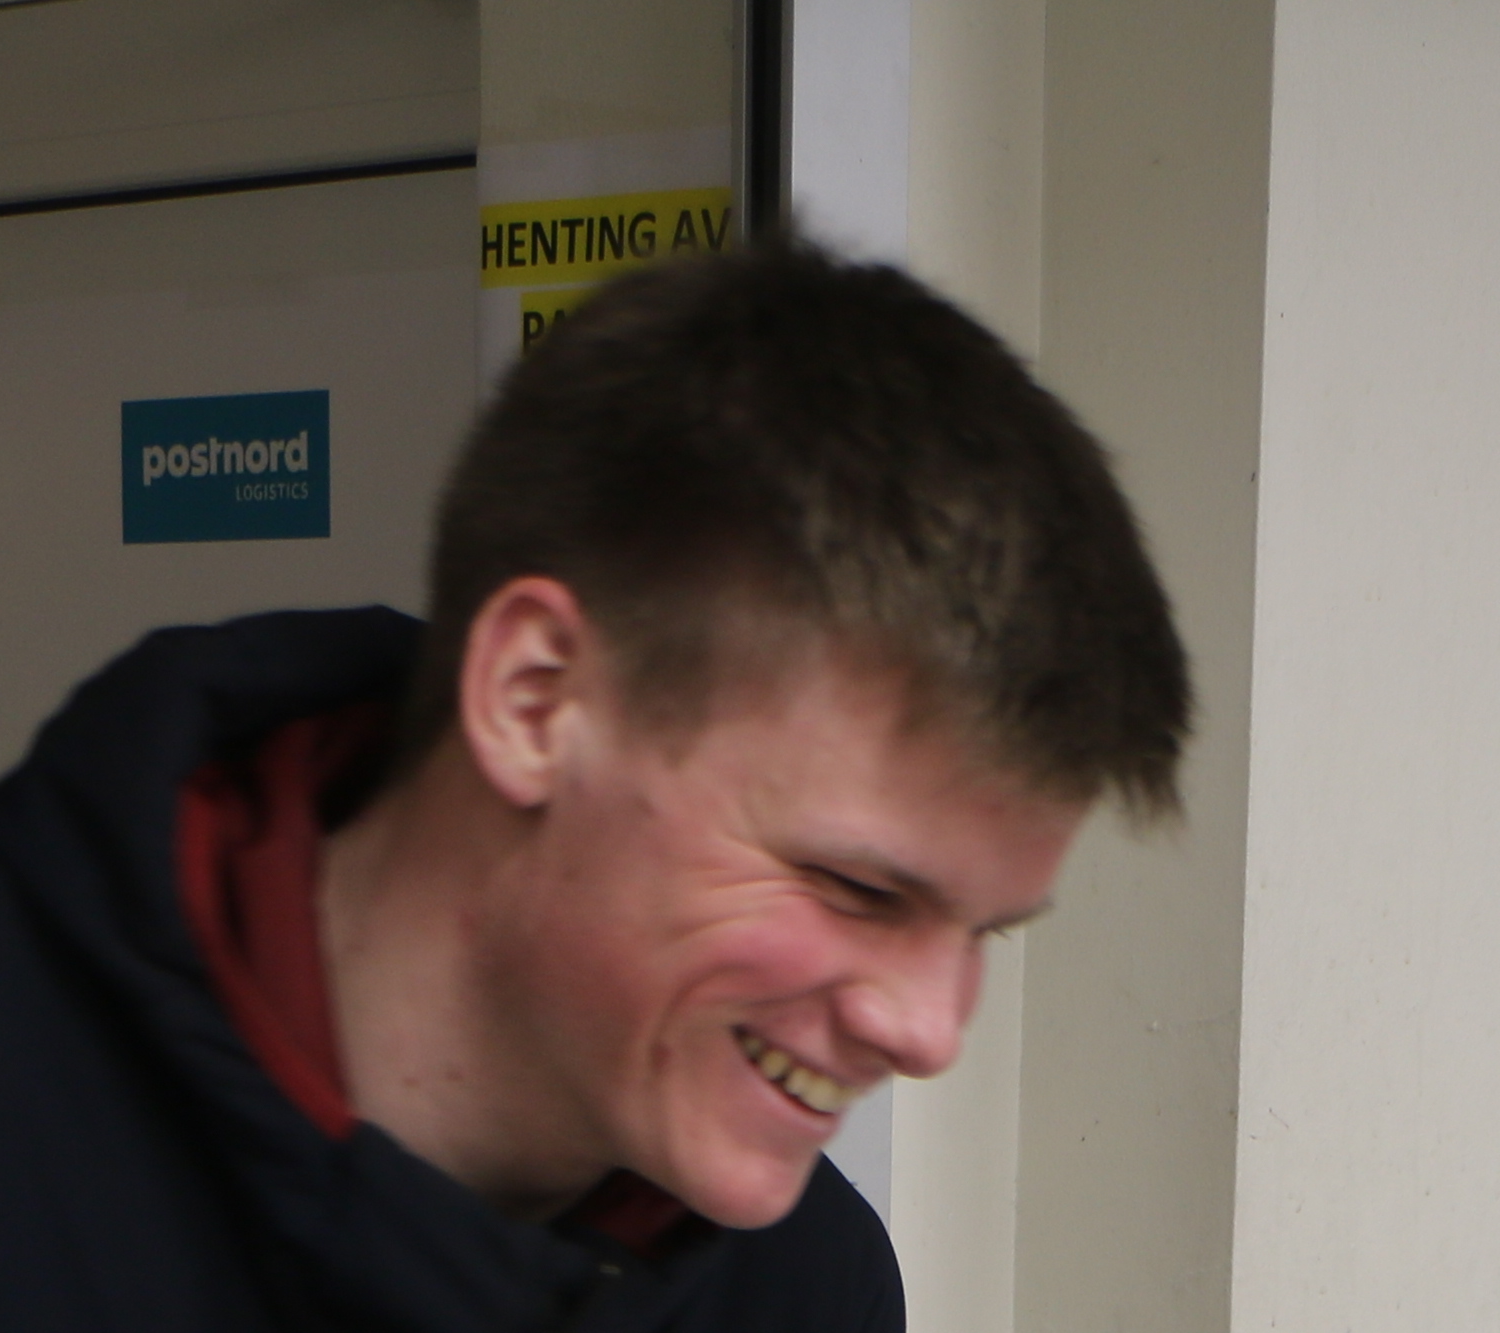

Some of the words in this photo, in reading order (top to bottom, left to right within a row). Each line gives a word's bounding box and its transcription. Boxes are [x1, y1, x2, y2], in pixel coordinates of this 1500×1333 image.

[481, 210, 658, 271] HENTING
[669, 205, 733, 258] AV
[143, 430, 309, 486] postnord
[235, 482, 309, 502] LOGISTICS
